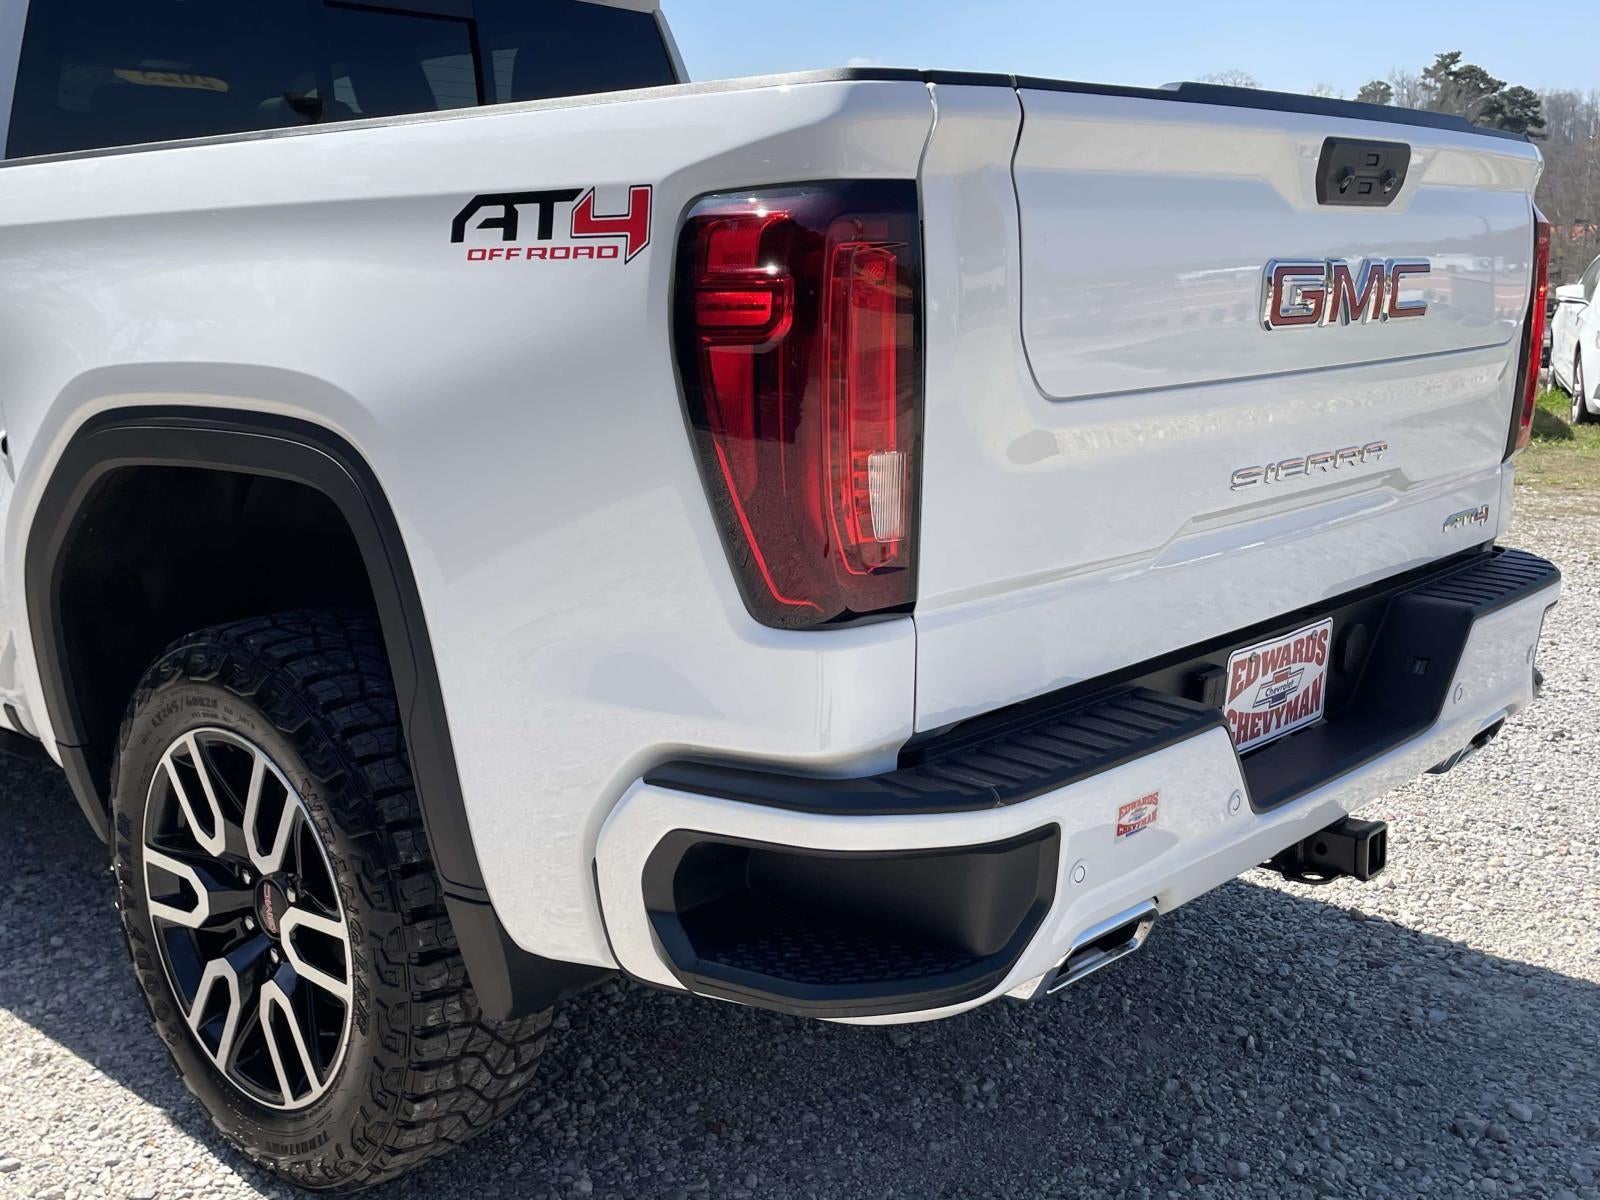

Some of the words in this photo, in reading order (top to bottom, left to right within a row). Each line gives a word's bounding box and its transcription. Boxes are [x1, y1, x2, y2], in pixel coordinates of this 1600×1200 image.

[451, 185, 652, 264] AT4
[1260, 258, 1431, 332] GMC
[1230, 440, 1388, 491] SIERRA
[1442, 504, 1489, 533] AT4
[1228, 628, 1329, 704] EDWARDS
[1265, 679, 1295, 697] Chevrolet
[1226, 671, 1323, 745] CHEVYMAN
[1118, 791, 1159, 821] EDWARDS
[262, 881, 277, 933] GMC
